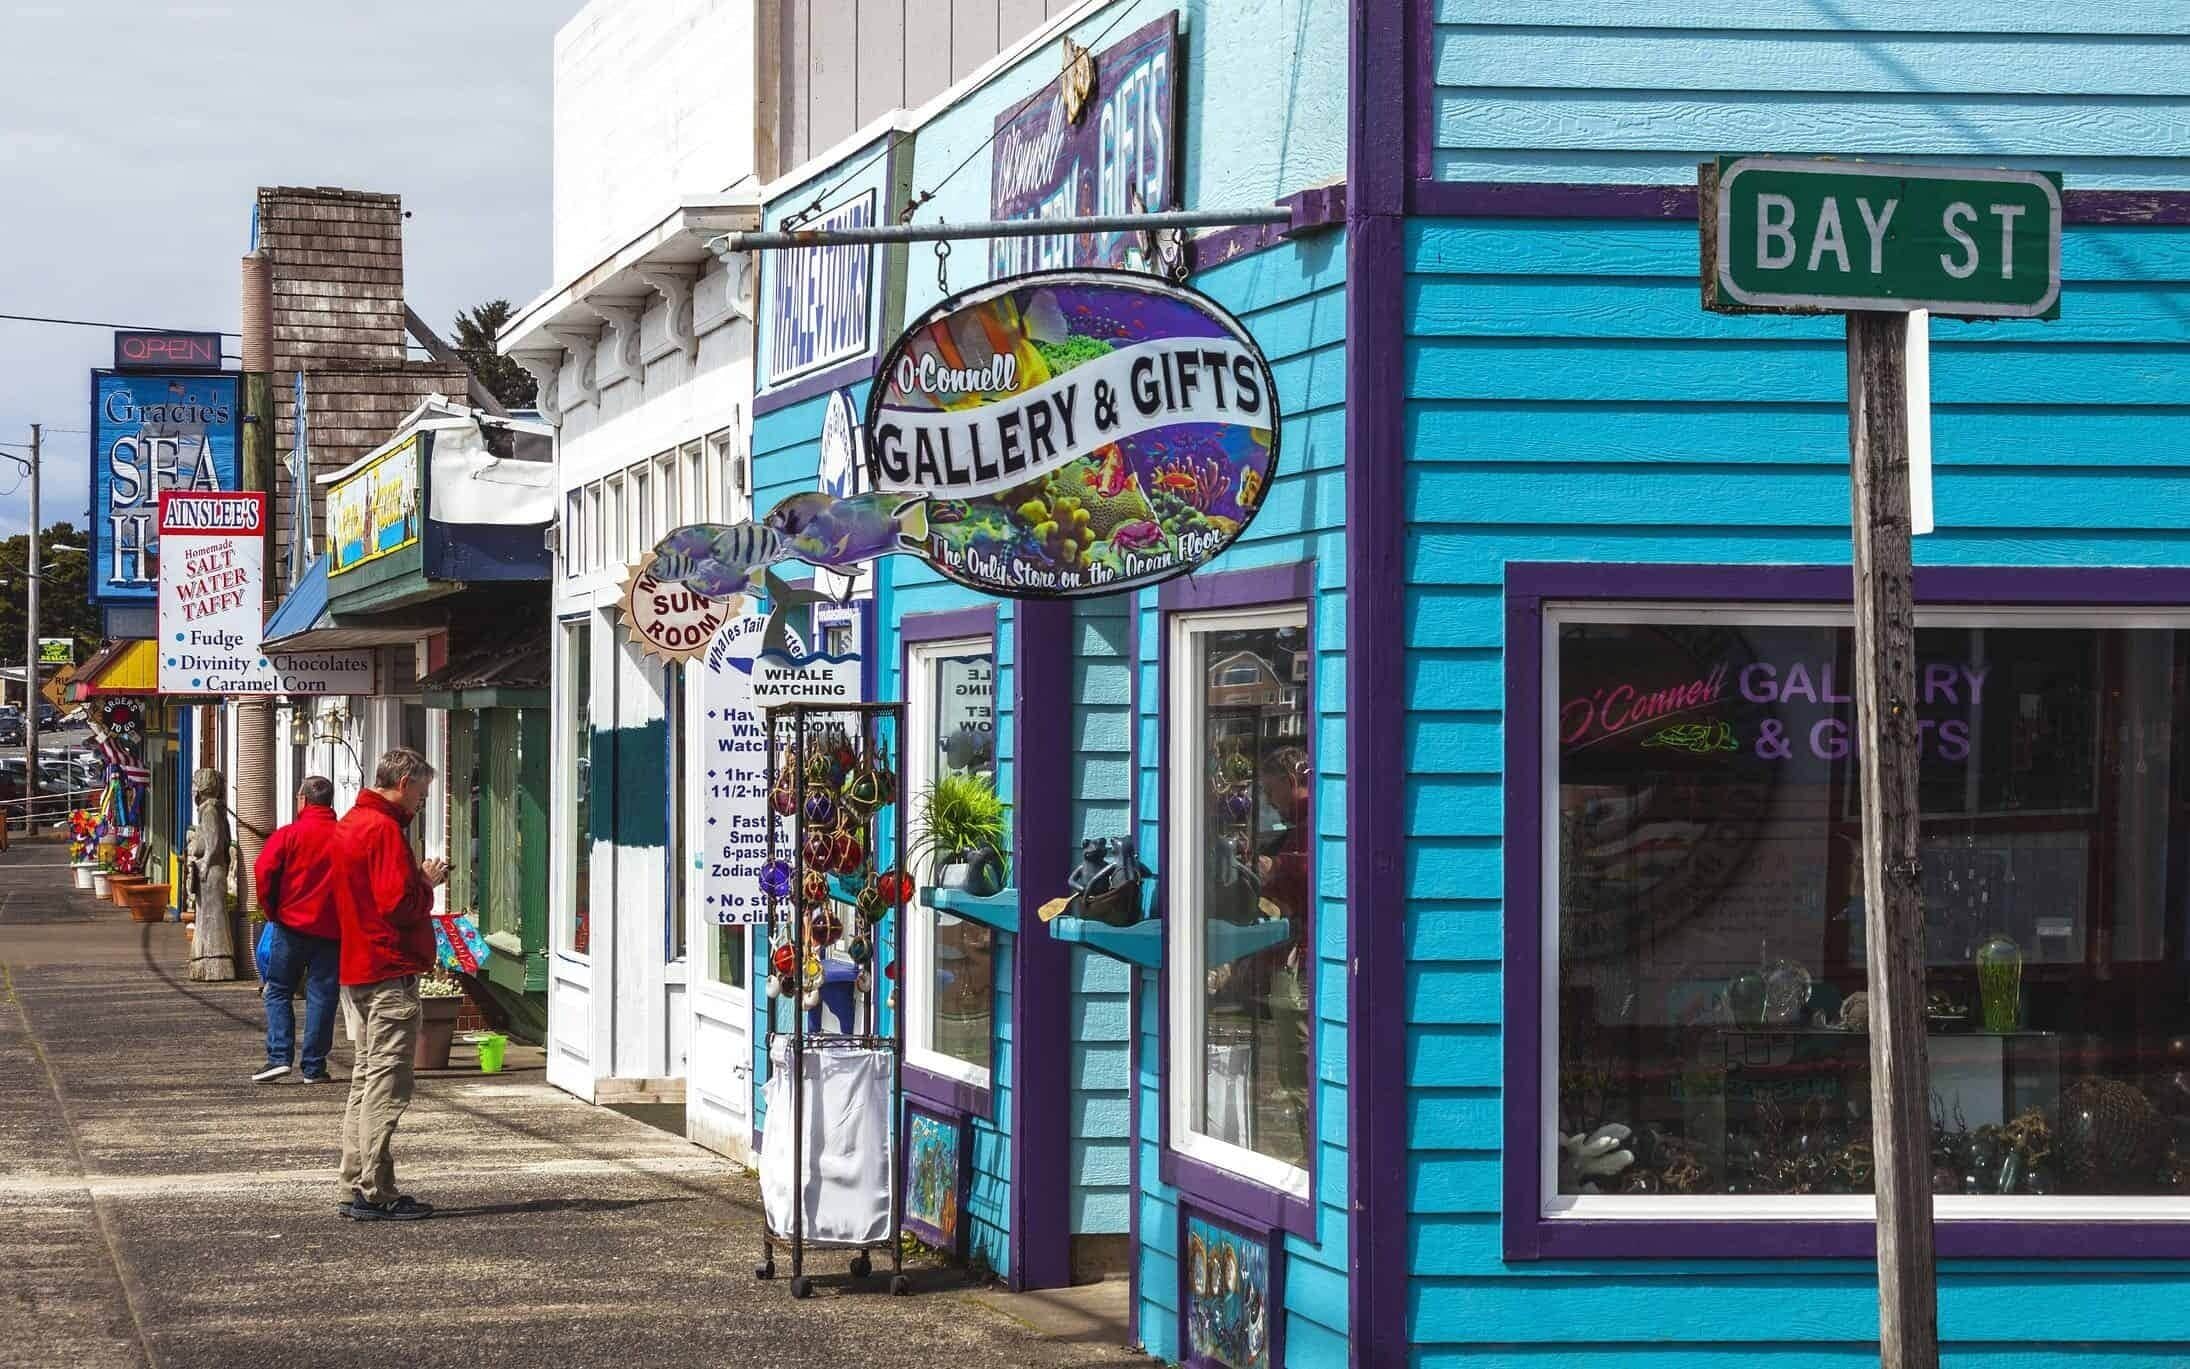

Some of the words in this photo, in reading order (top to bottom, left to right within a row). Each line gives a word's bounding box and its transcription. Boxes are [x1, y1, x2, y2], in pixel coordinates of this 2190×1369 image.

[1756, 193, 1898, 275] BAY
[1940, 201, 2026, 280] ST
[123, 337, 213, 361] OPEN
[896, 352, 1021, 396] O'Connell
[105, 389, 230, 425] Gracie's
[876, 381, 1079, 488] GALLERY
[1093, 378, 1122, 433] &
[1130, 350, 1261, 418] GIFTS
[110, 431, 221, 508] SEA
[164, 499, 259, 529] AINSLEE'S
[185, 538, 233, 560] Homemade
[186, 549, 235, 578] SALT
[930, 533, 962, 569] The
[967, 549, 1007, 585] Only
[1012, 559, 1057, 587] Store
[1060, 571, 1081, 588] on
[1088, 561, 1115, 585] the
[1125, 552, 1172, 577] Ocean
[176, 567, 250, 602] WATER
[182, 589, 246, 621] TAFFY
[653, 592, 710, 616] SUN
[190, 630, 243, 650] Fudge
[646, 613, 721, 646] ROOM
[709, 624, 741, 674] Whales
[743, 616, 765, 634] Tail
[181, 655, 250, 674] Divinity
[273, 655, 368, 672] Chocolates
[765, 669, 834, 681] WHALE
[206, 675, 277, 692] Caramel
[283, 676, 326, 692] Corn
[754, 684, 846, 695] WATCHING
[1738, 663, 1991, 706] GALRY
[104, 697, 138, 712] ORDERS
[1560, 661, 1729, 743] O'Connell
[1755, 718, 1792, 760] &
[1809, 718, 1971, 761] GTS
[733, 815, 766, 828] Fast
[721, 894, 744, 906] No
[719, 912, 736, 923] to
